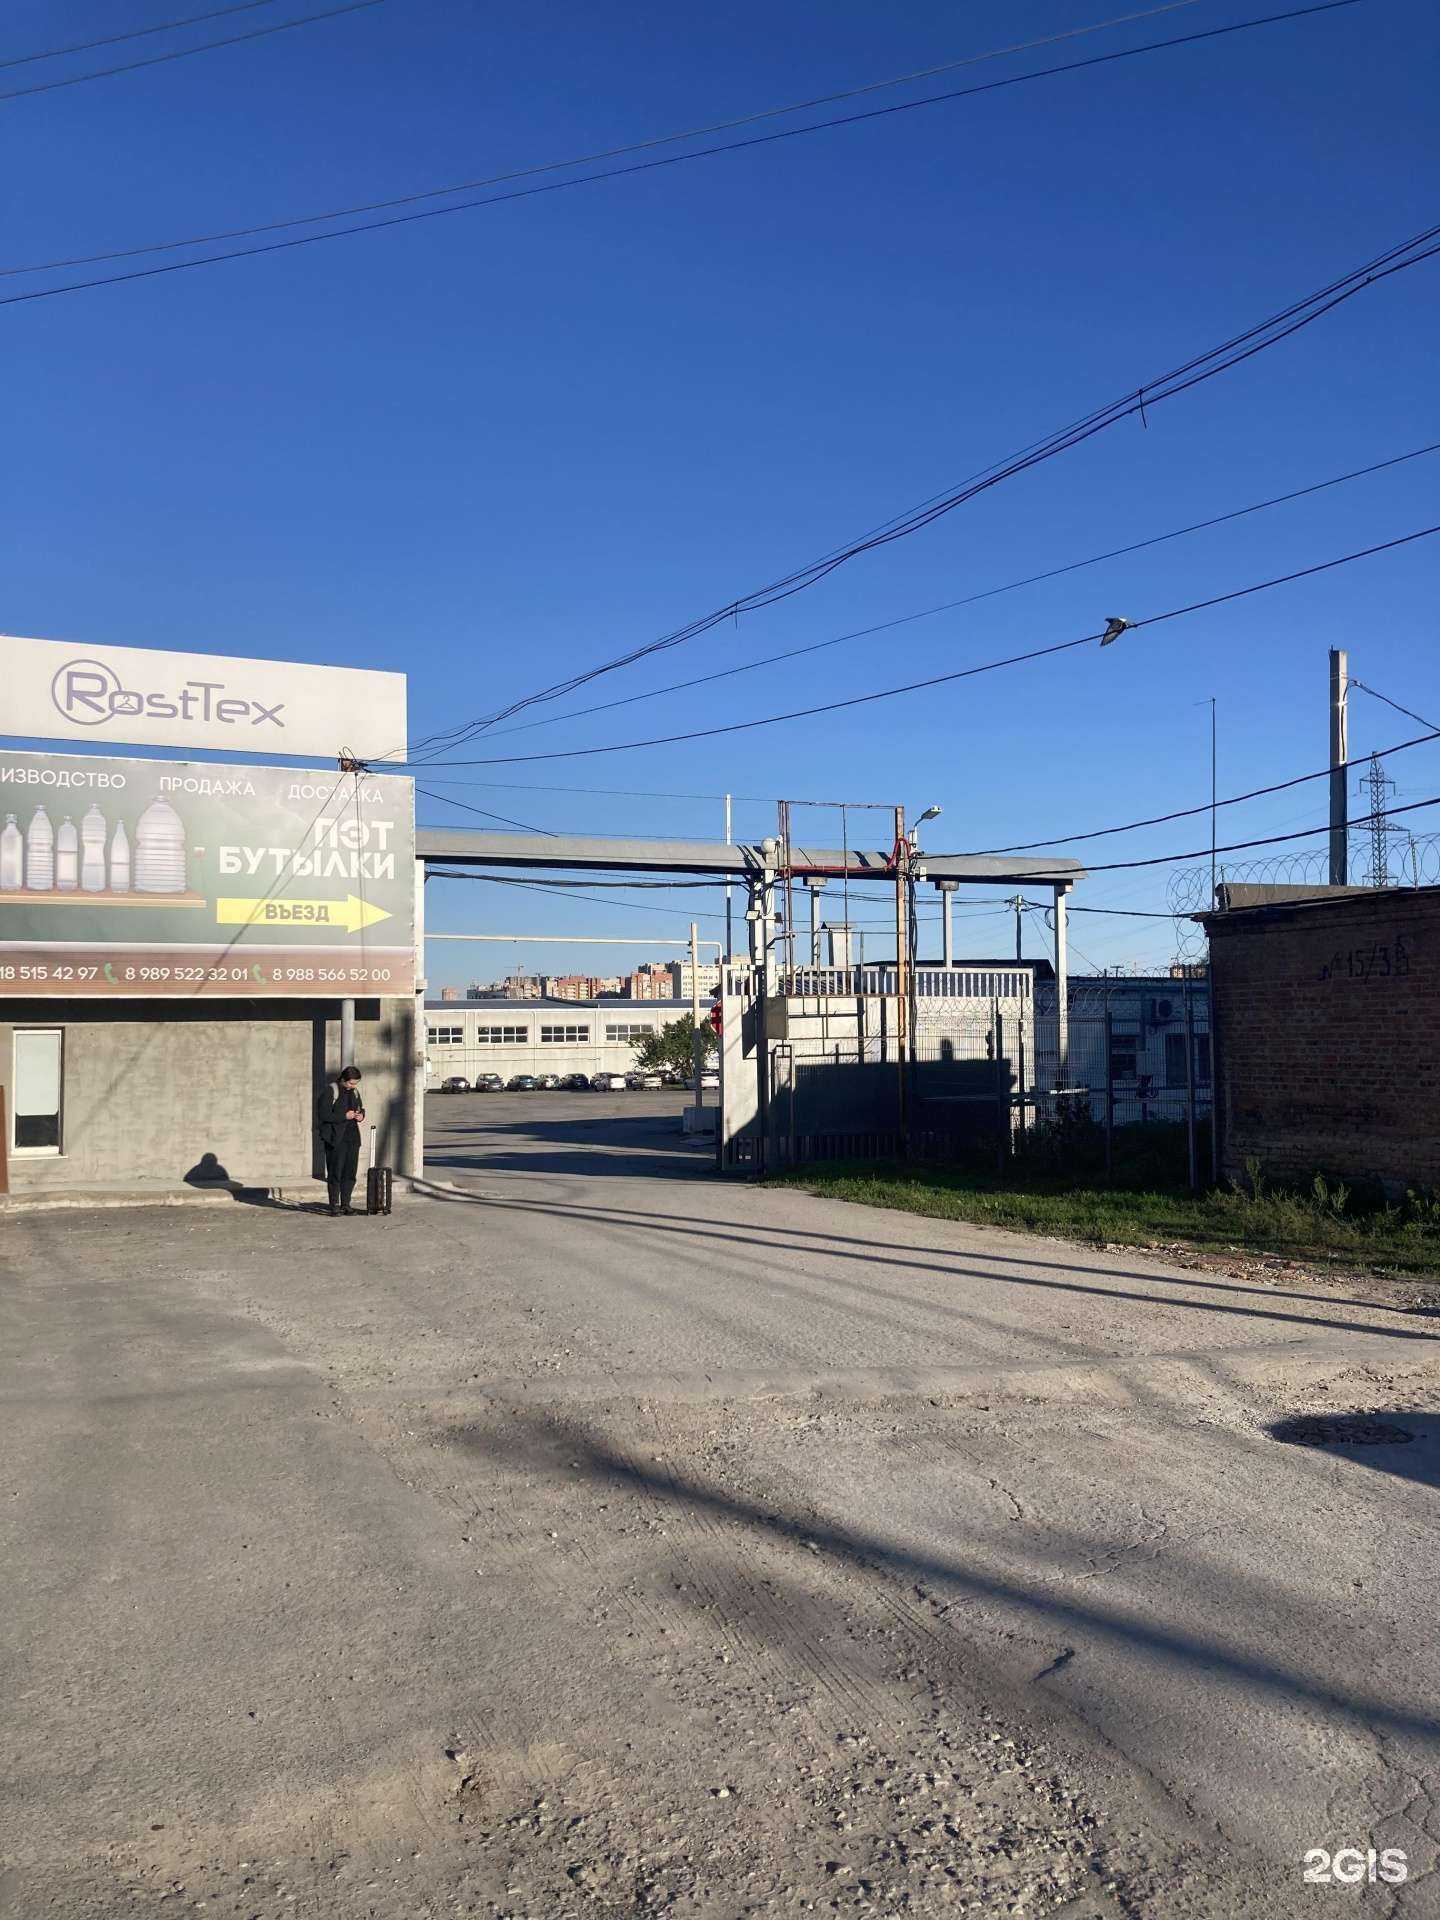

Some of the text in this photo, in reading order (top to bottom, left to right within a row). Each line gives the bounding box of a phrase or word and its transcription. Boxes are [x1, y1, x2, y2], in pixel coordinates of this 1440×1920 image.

[66, 670, 286, 728] RostTex
[1, 767, 384, 804] ИЗВОДСТВО ПРОДАЖА ДОСТАВКА
[313, 818, 395, 851] ПЭТ
[218, 845, 396, 880] БУТЫЛКИ
[265, 903, 330, 923] ВЪЕЗД
[20, 966, 48, 980] 515
[52, 966, 74, 980] 42
[77, 966, 98, 980] 97
[125, 967, 248, 981] 8 989 522 32 01
[272, 968, 391, 981] 8 988 566 52 00
